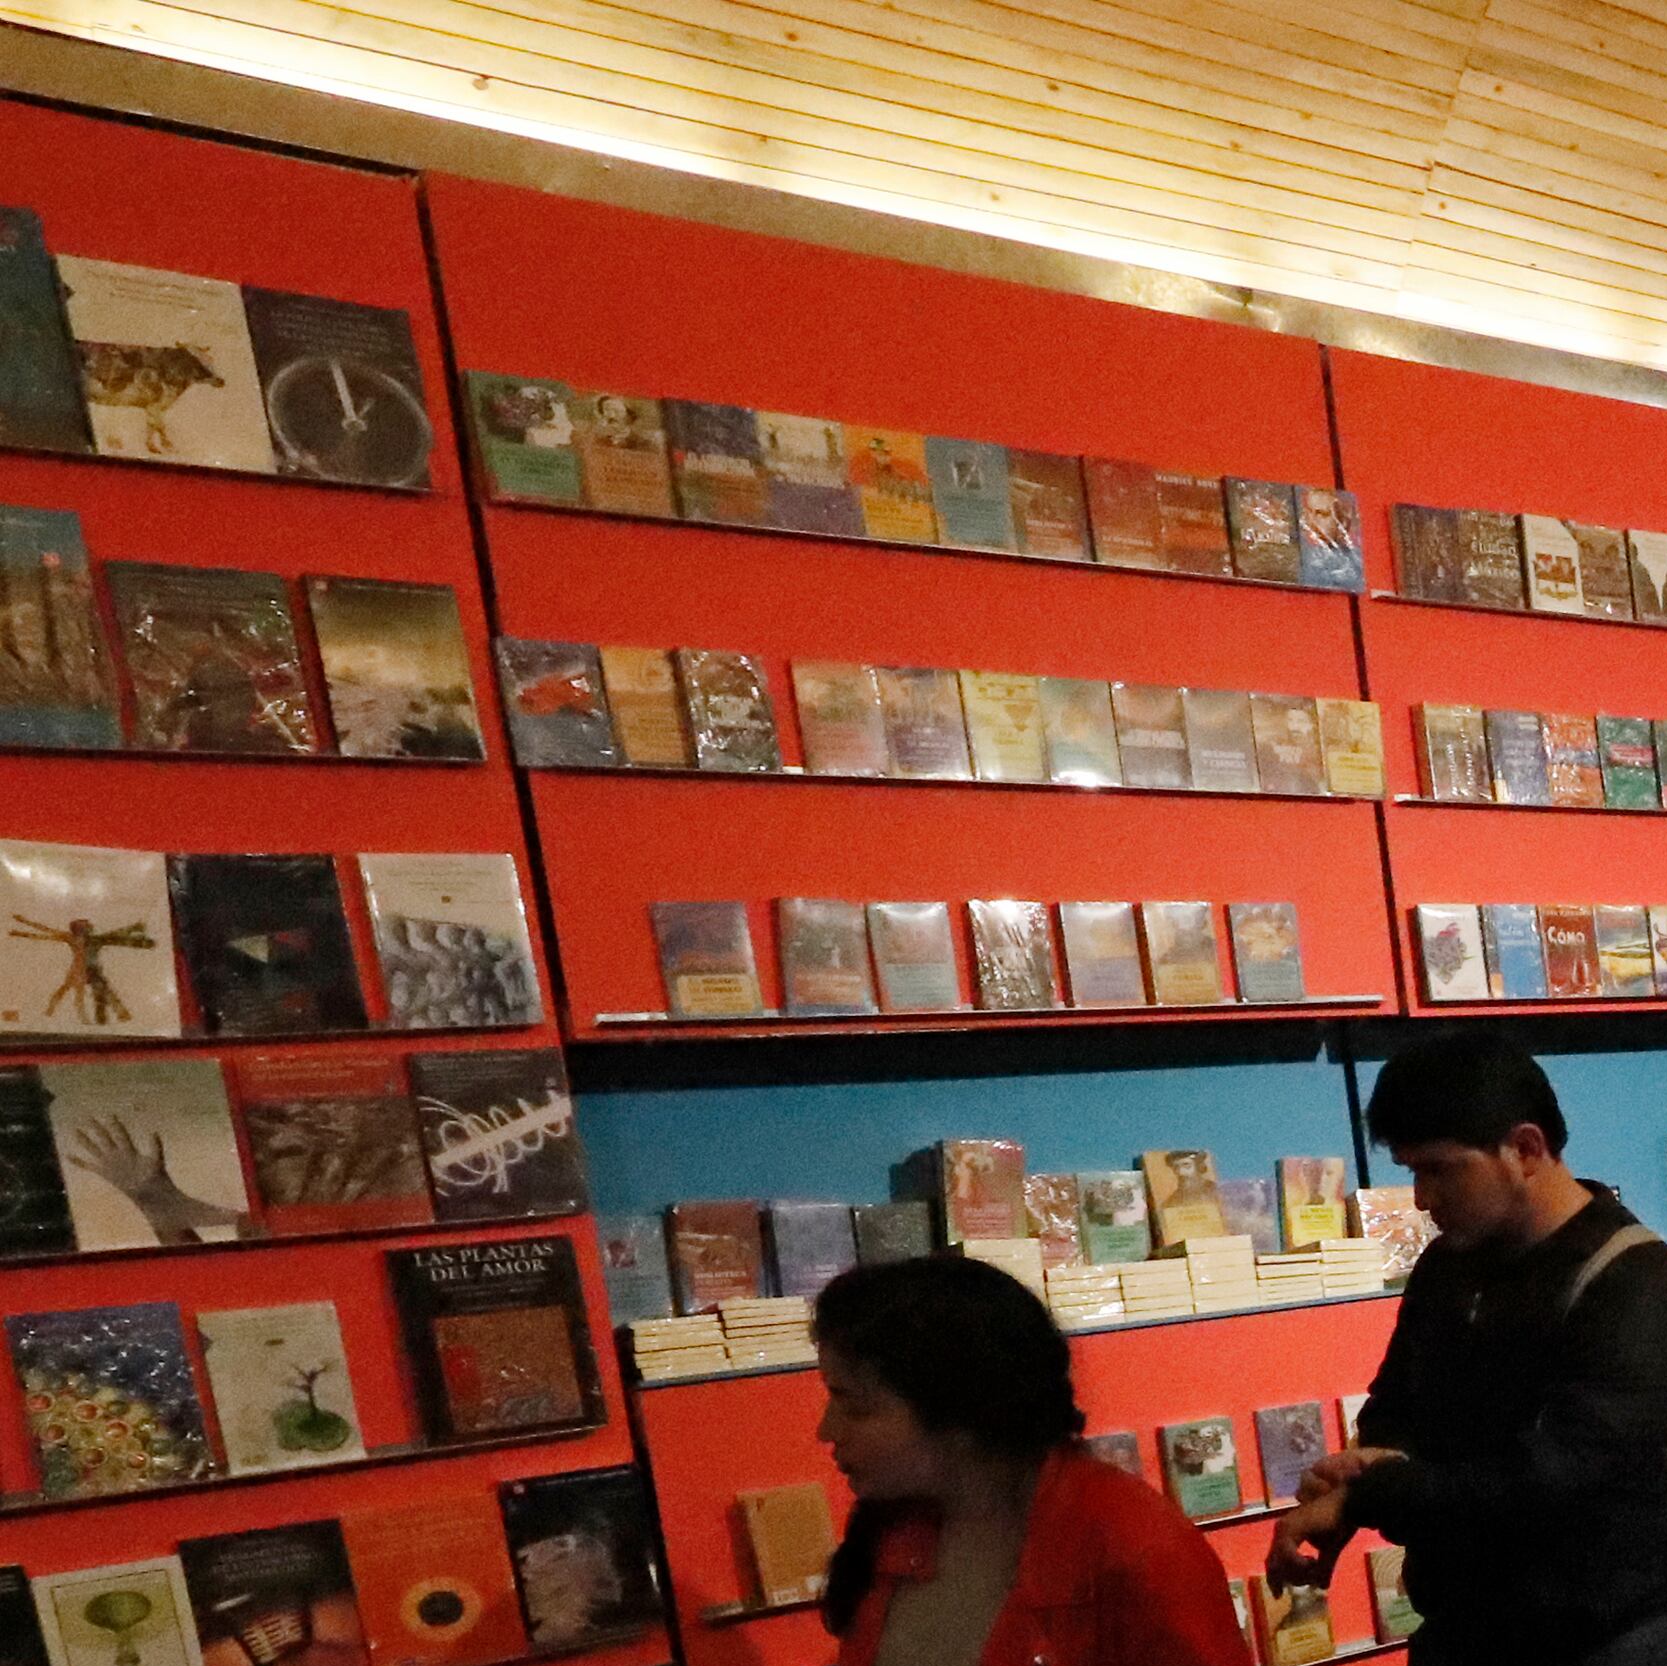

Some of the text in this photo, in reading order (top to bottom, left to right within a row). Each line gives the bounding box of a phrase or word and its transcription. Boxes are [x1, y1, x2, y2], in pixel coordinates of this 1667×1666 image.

[413, 1242, 554, 1268] LAS PLANTAS
[430, 1258, 548, 1283] DEL AMOR
